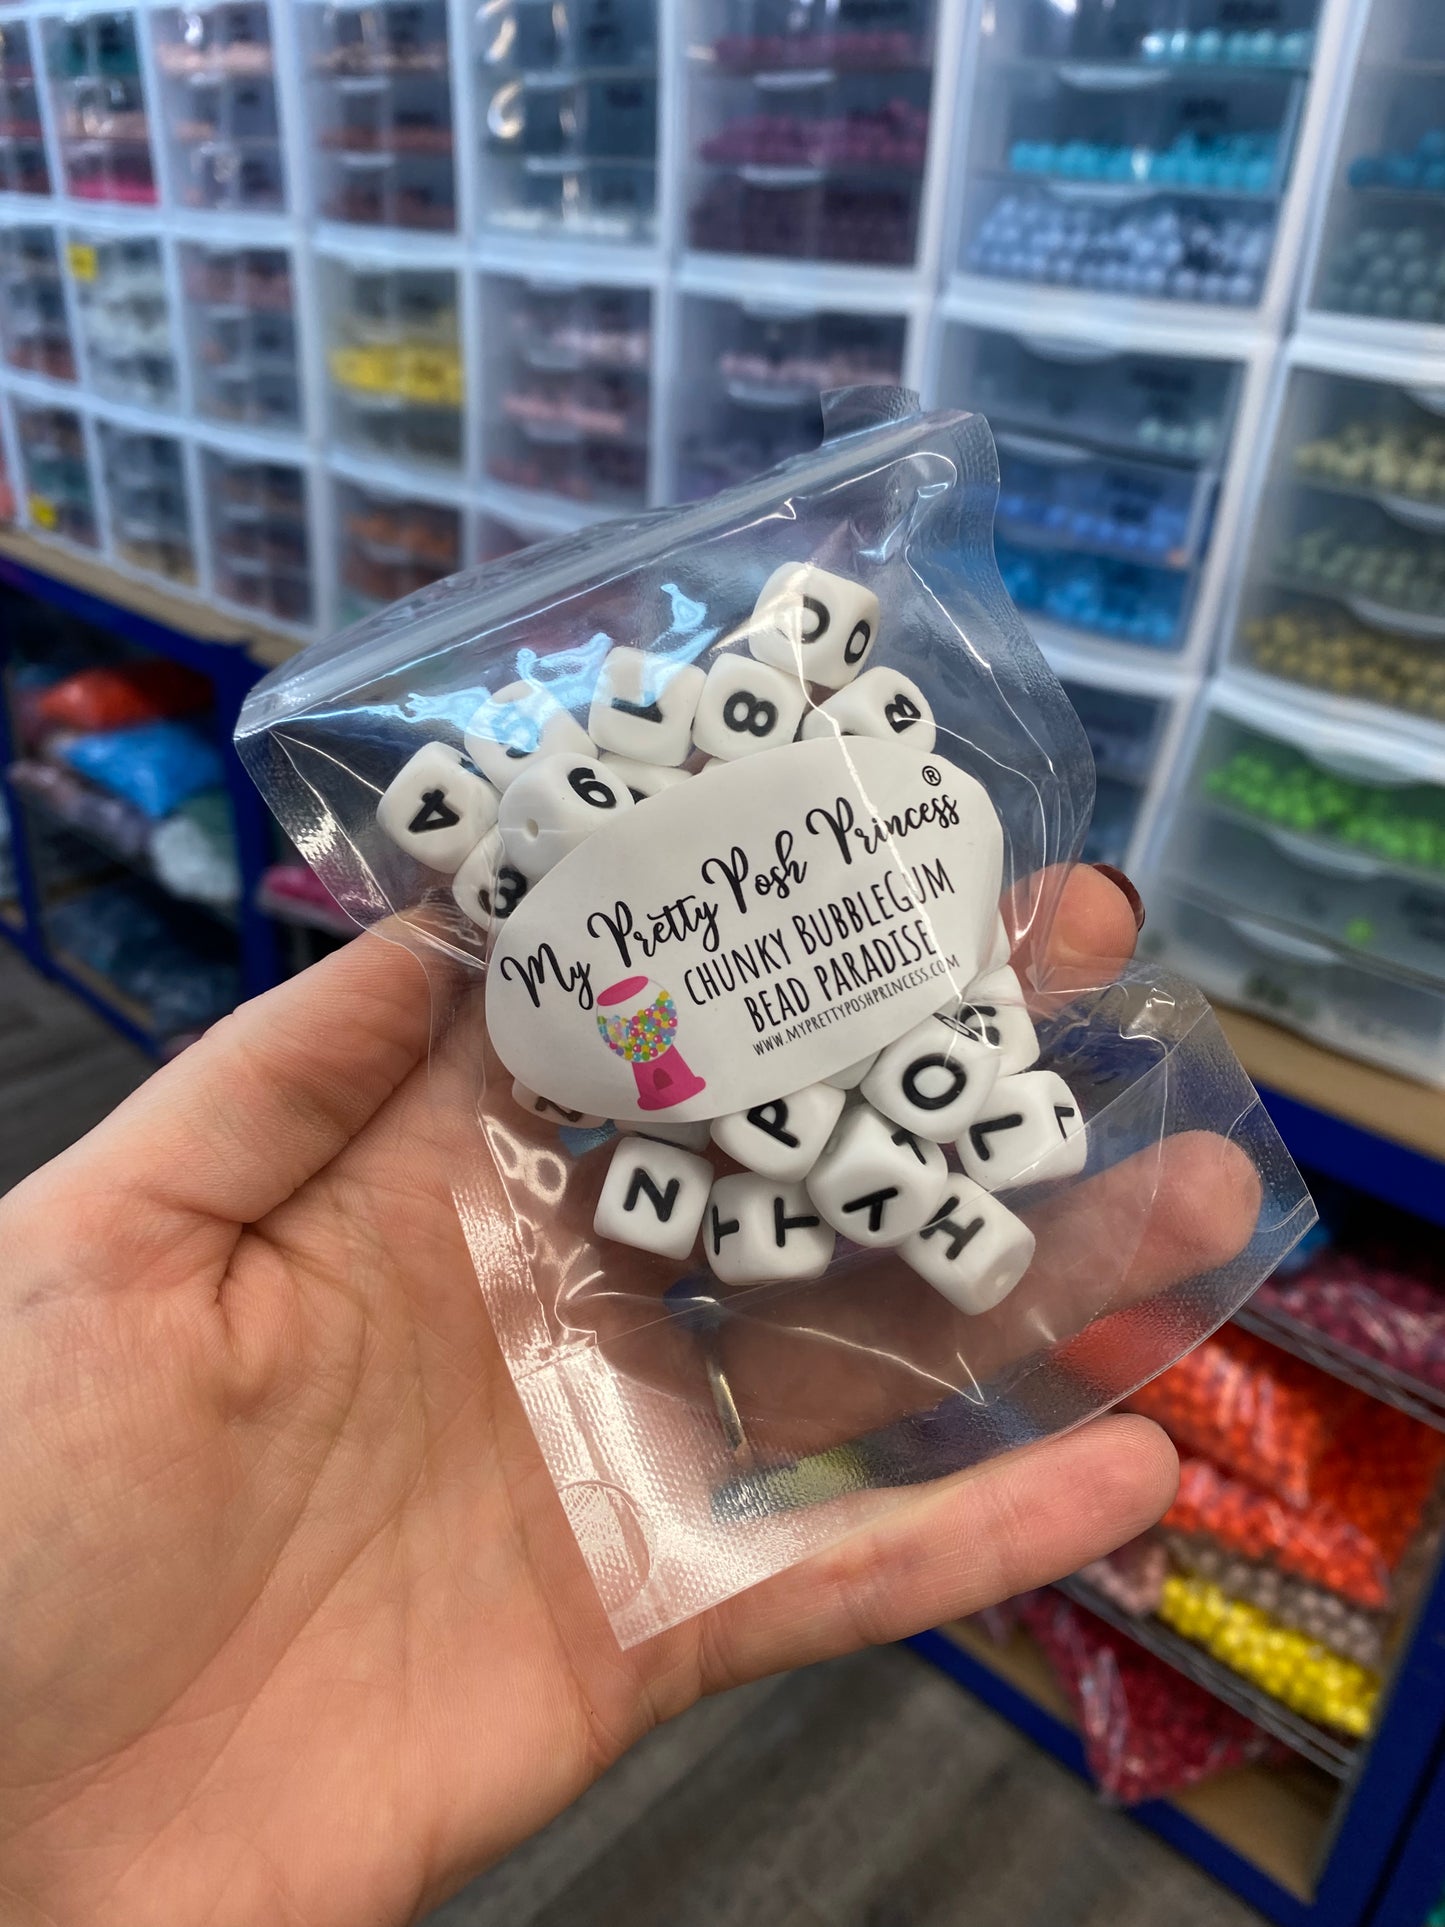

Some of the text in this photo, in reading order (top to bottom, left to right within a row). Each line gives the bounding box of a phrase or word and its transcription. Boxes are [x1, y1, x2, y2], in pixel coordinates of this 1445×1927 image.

[723, 691, 778, 737] 8
[408, 789, 460, 833] 4
[500, 794, 960, 1010] My Pretty Posh Princess
[684, 858, 955, 1006] CHUNKY BUBBLEGUM
[743, 919, 936, 1033] BEAD PARADISE
[752, 954, 960, 1056] WWW.MYPRETTYPOSHPRINCESS.COM
[747, 1099, 799, 1148] P
[774, 1197, 820, 1248] T
[919, 1196, 985, 1260] H
